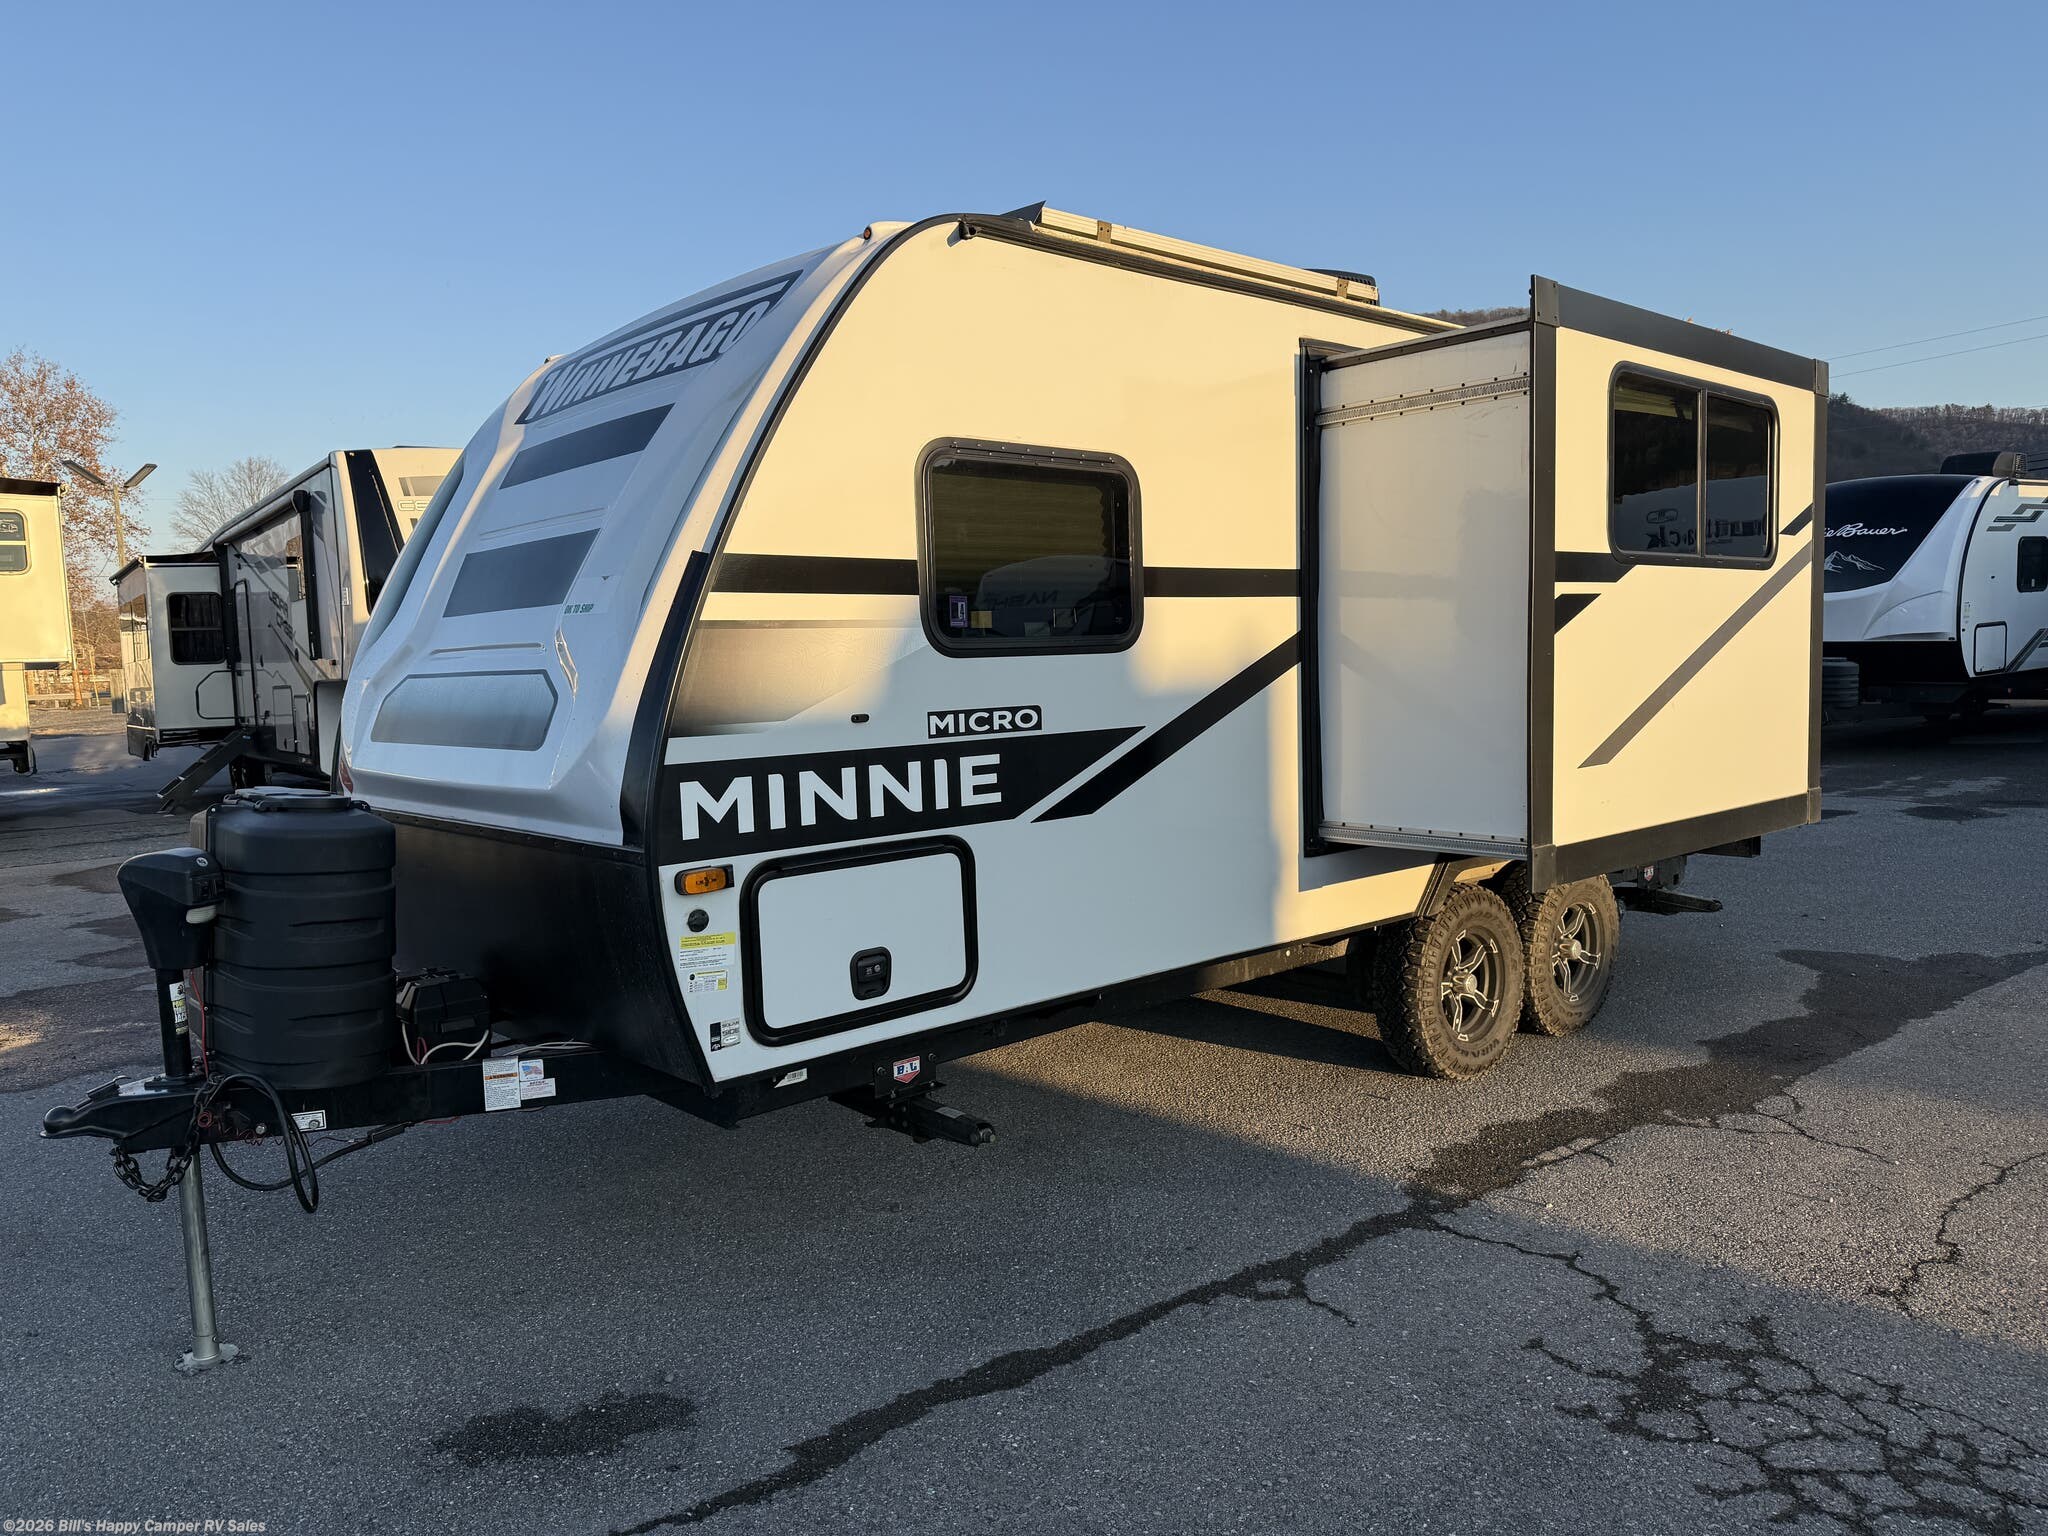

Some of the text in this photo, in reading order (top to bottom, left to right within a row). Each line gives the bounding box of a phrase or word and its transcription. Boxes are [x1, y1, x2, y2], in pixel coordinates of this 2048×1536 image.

[524, 300, 770, 421] WINNEBAGO
[1836, 522, 1908, 538] Bauer
[928, 708, 1040, 736] MICRO
[679, 753, 1002, 841] MINNIE
